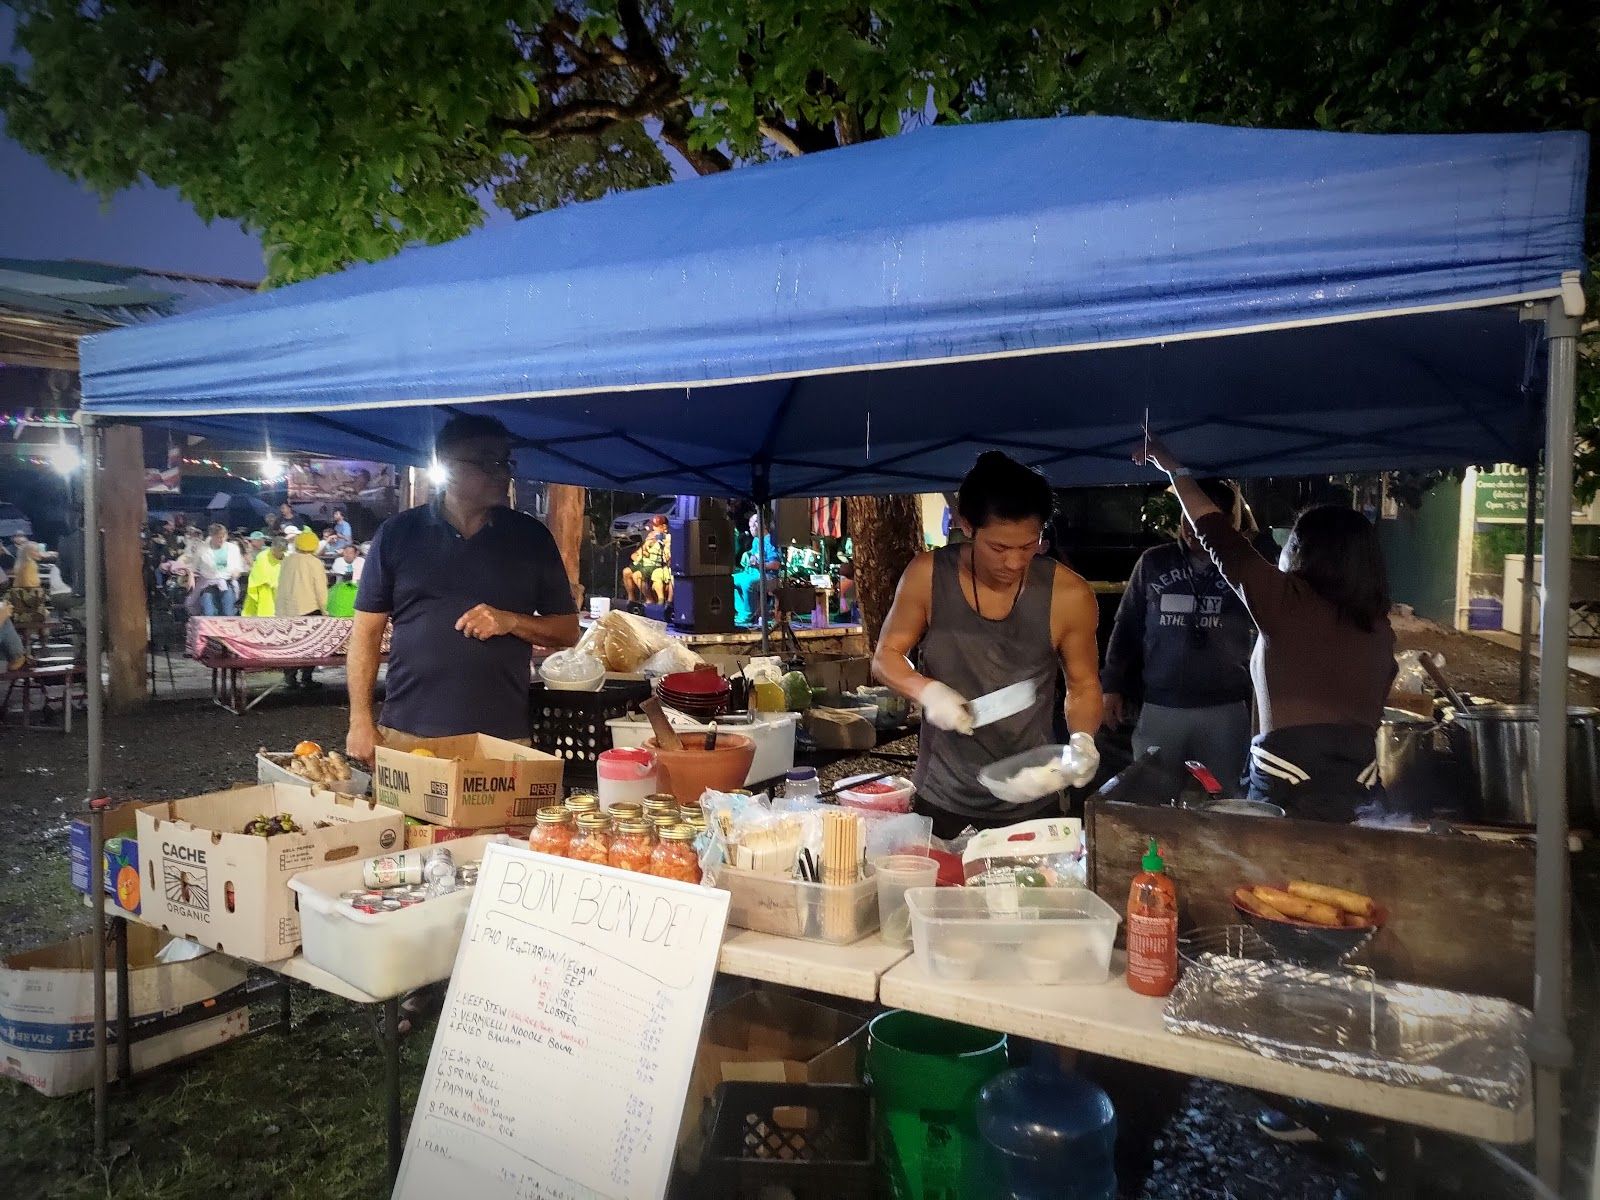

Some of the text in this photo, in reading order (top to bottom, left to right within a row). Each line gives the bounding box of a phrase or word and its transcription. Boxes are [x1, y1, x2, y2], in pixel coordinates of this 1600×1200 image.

[377, 764, 411, 794] MELONA
[462, 776, 516, 793] MELONA
[379, 788, 400, 808] MELON
[462, 793, 496, 807] MELON
[162, 841, 206, 864] CACHE
[498, 861, 565, 914] BON
[571, 874, 641, 938] BON
[167, 902, 211, 924] ORGANIC
[484, 928, 502, 946] PHO
[485, 999, 508, 1017] STEW
[544, 1003, 578, 1028] LOBSTER
[487, 1030, 522, 1047] BANANA
[511, 1023, 544, 1044] NOODLE
[476, 1055, 496, 1073] ROLL
[447, 1065, 478, 1084] SPRING
[481, 1073, 501, 1091] ROLL
[442, 1080, 474, 1099] PAPAYA
[437, 1102, 460, 1120] PORK
